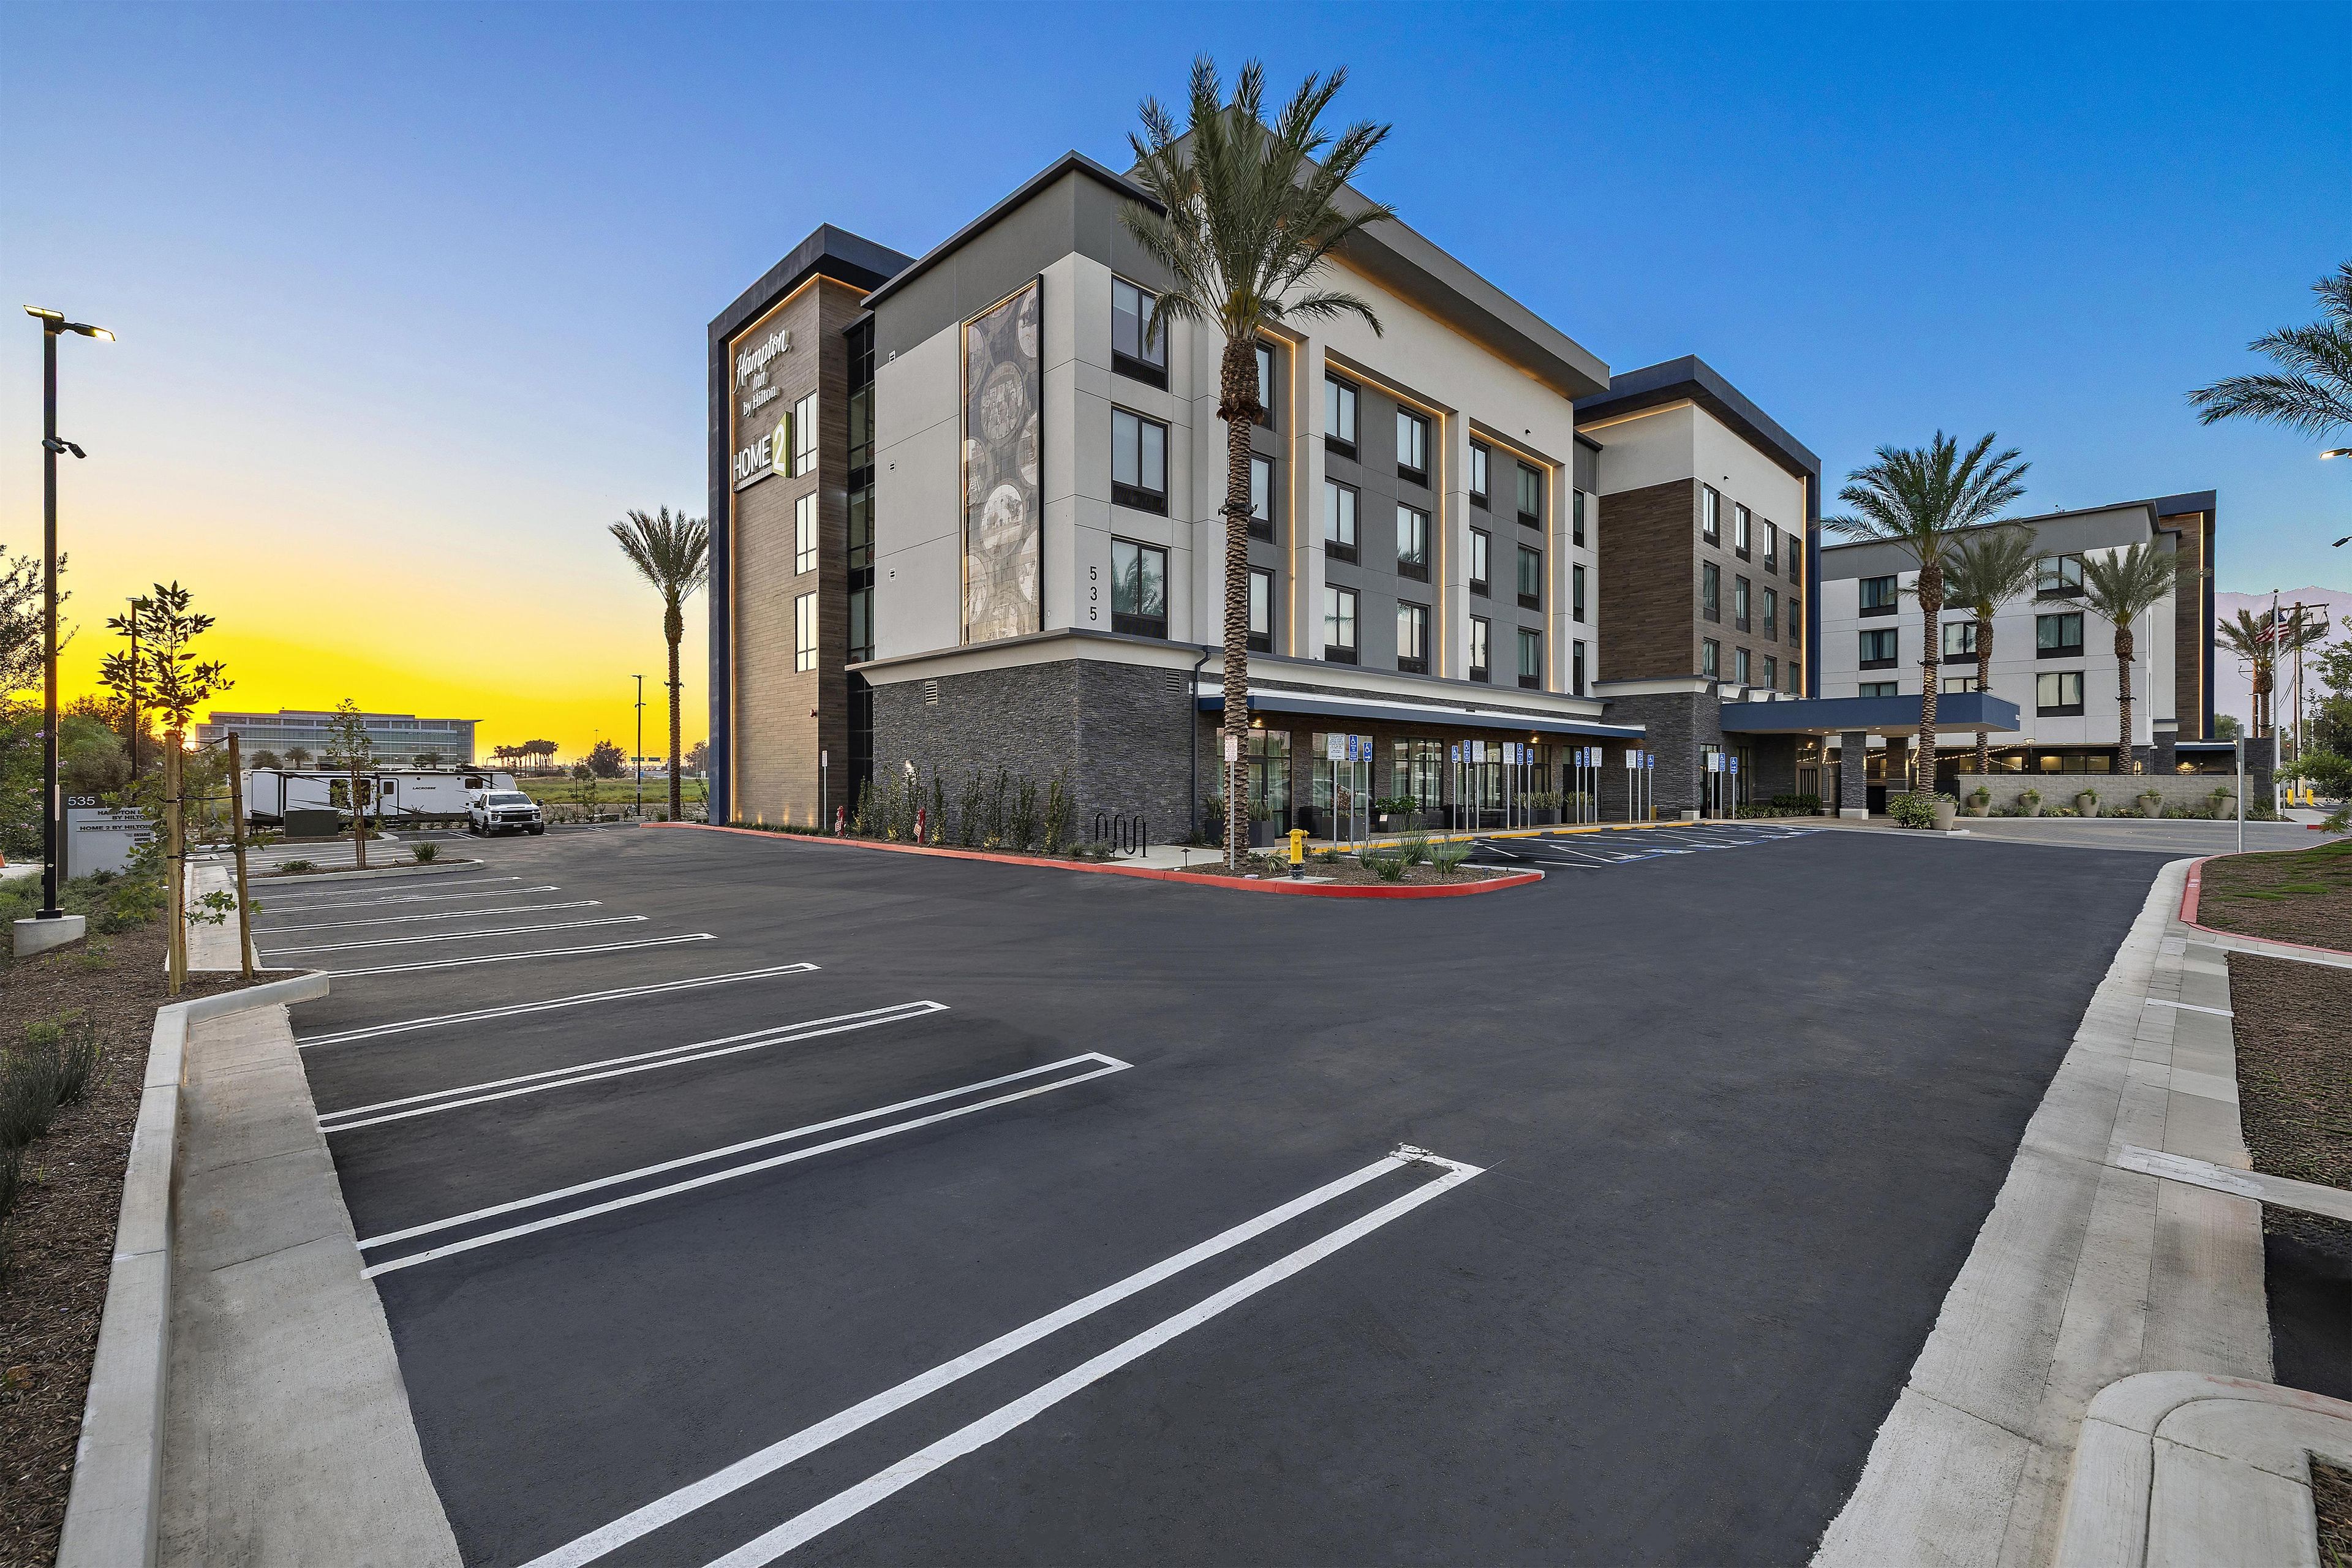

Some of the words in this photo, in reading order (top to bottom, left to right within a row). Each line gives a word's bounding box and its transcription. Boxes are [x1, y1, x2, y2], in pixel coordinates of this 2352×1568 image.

[733, 330, 788, 394] Hampton
[753, 371, 766, 391] Inn
[743, 402, 752, 417] by
[753, 386, 776, 409] Hilton
[734, 434, 771, 482] HOME
[774, 424, 785, 472] 2
[68, 796, 96, 806] 535
